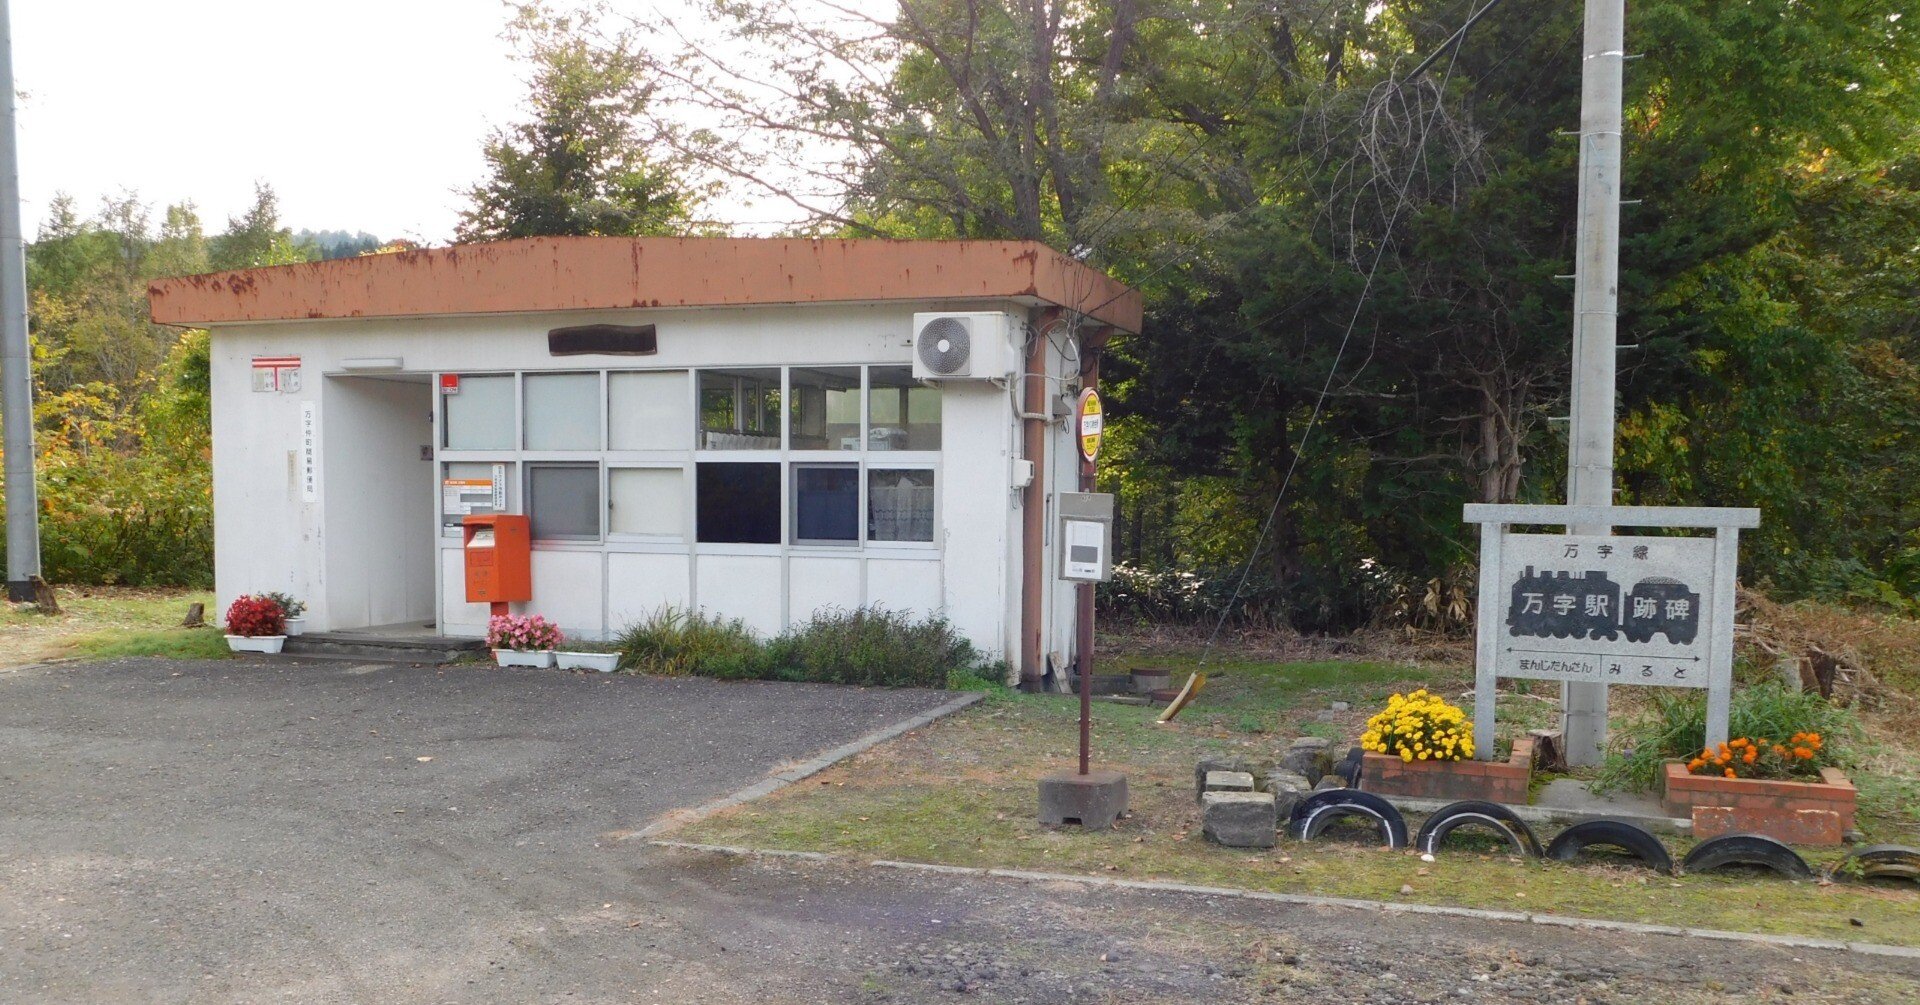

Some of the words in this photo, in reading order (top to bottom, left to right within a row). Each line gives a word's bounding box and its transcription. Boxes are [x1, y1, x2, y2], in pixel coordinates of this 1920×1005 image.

[1563, 543, 1649, 560] 万字線
[1608, 663, 1687, 679] みると
